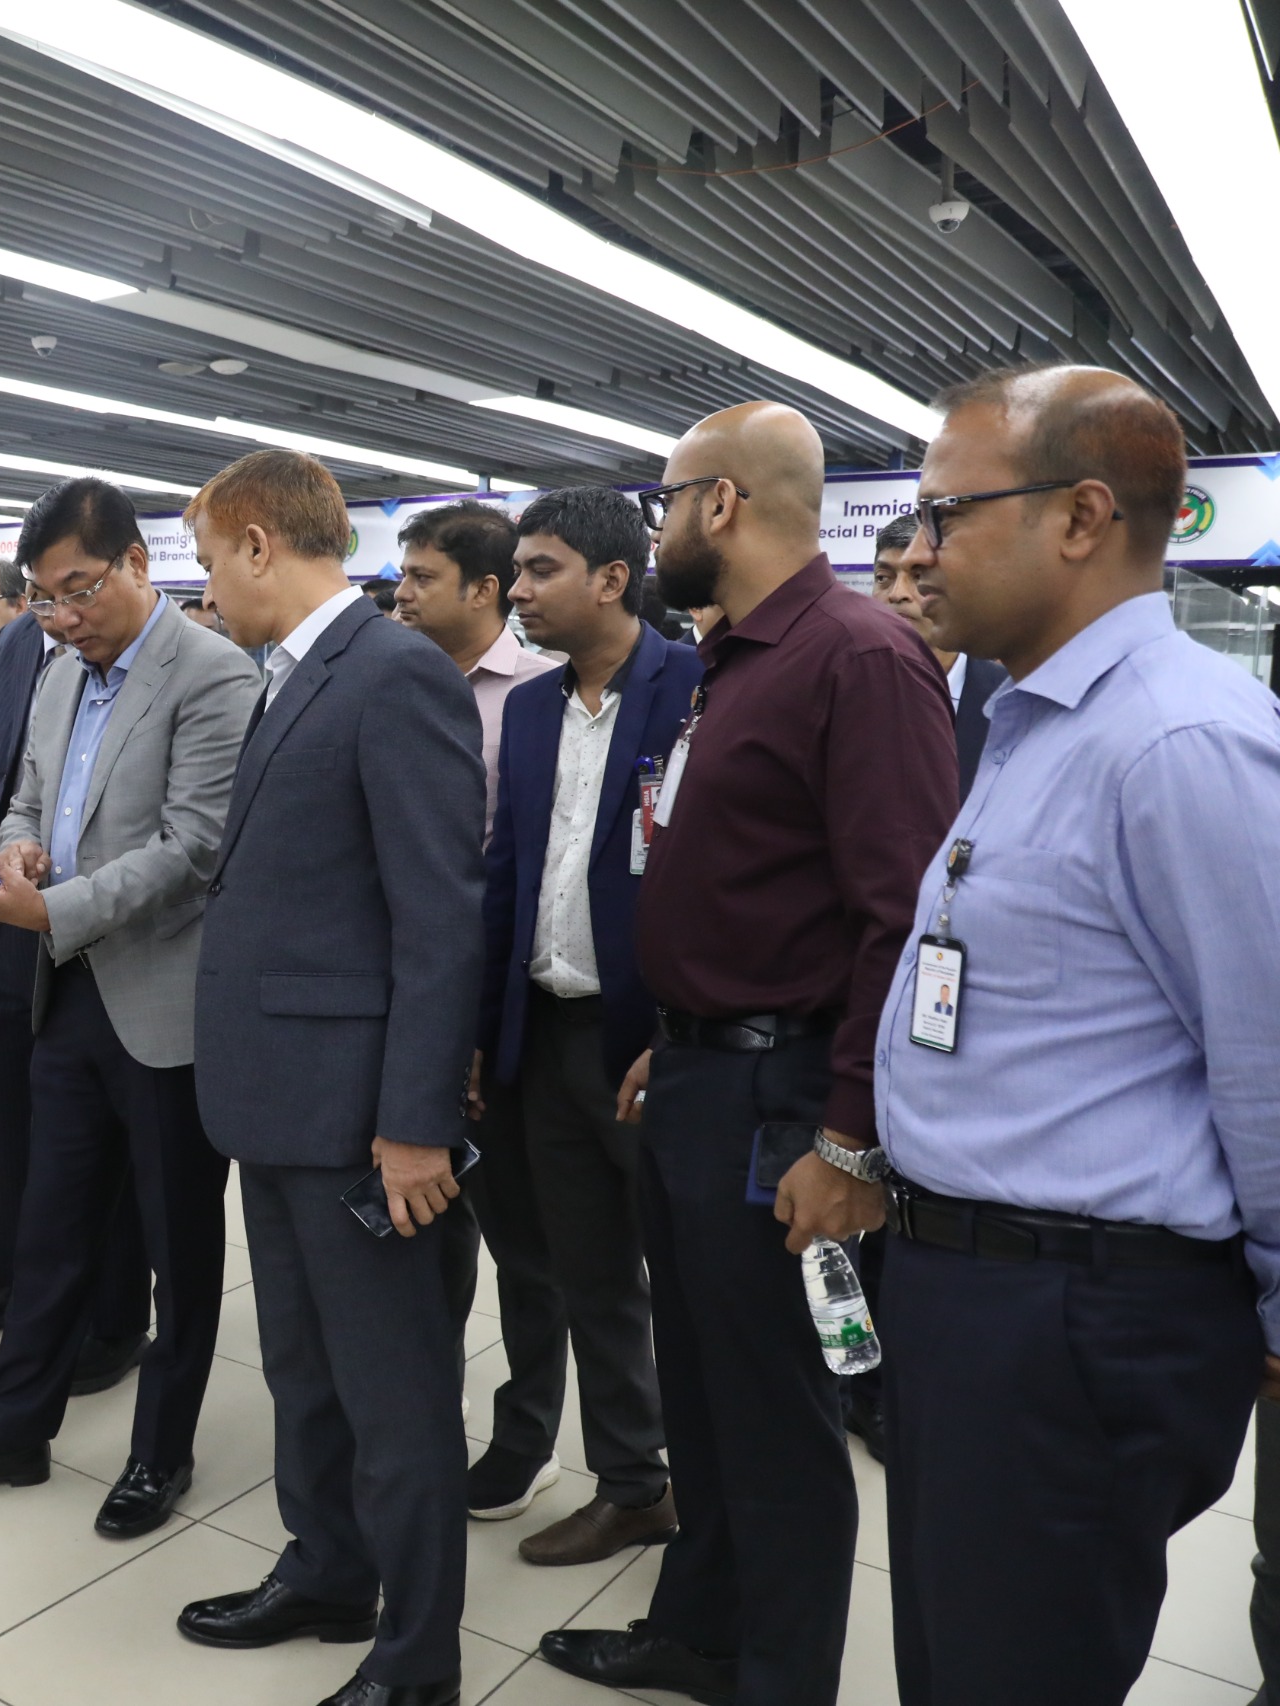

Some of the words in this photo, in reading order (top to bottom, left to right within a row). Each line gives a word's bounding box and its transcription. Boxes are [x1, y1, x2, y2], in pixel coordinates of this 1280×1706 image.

[843, 499, 912, 517] Immig
[148, 532, 195, 549] Immigr
[819, 525, 857, 539] ecial
